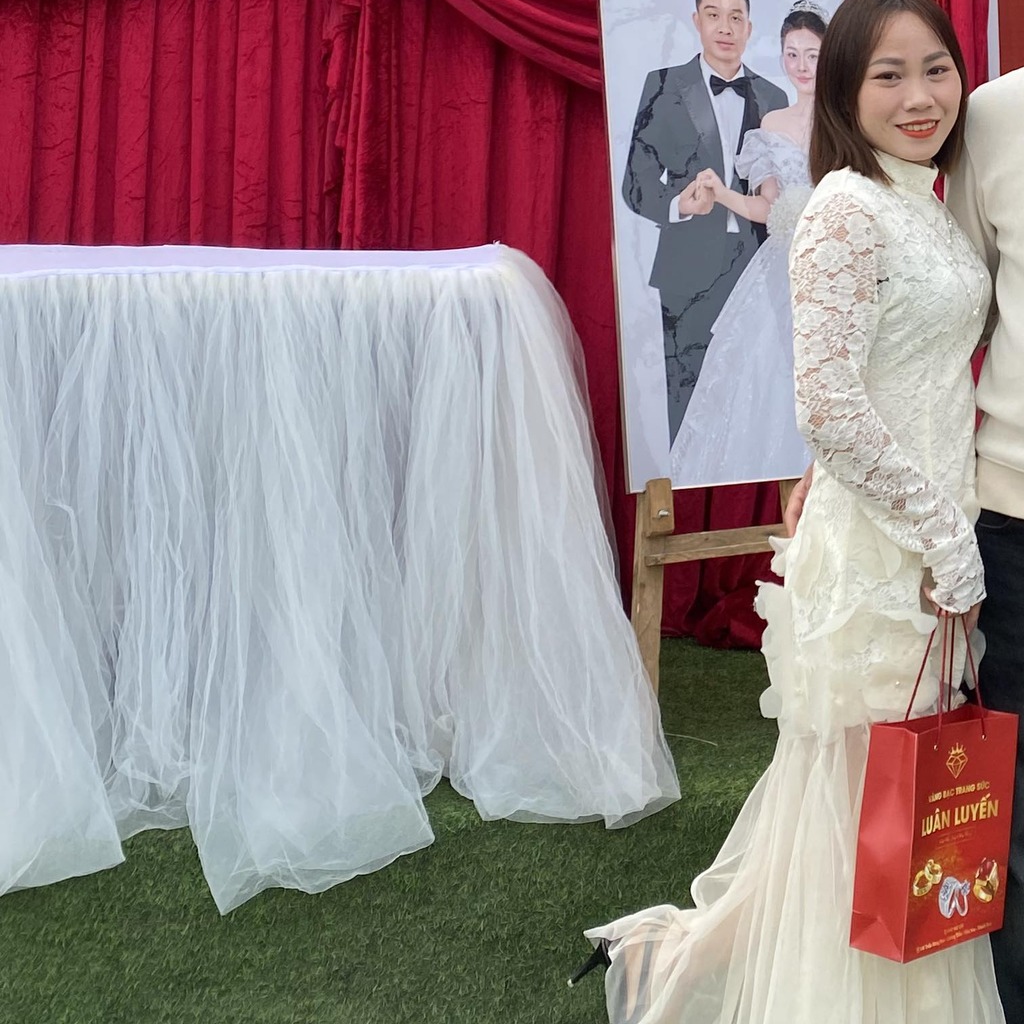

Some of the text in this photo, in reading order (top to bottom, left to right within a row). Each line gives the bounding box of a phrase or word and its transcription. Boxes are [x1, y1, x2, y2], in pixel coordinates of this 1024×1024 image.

[955, 783, 976, 795] TRANG
[921, 808, 951, 837] LUÂN
[954, 793, 999, 826] LUYẾN
